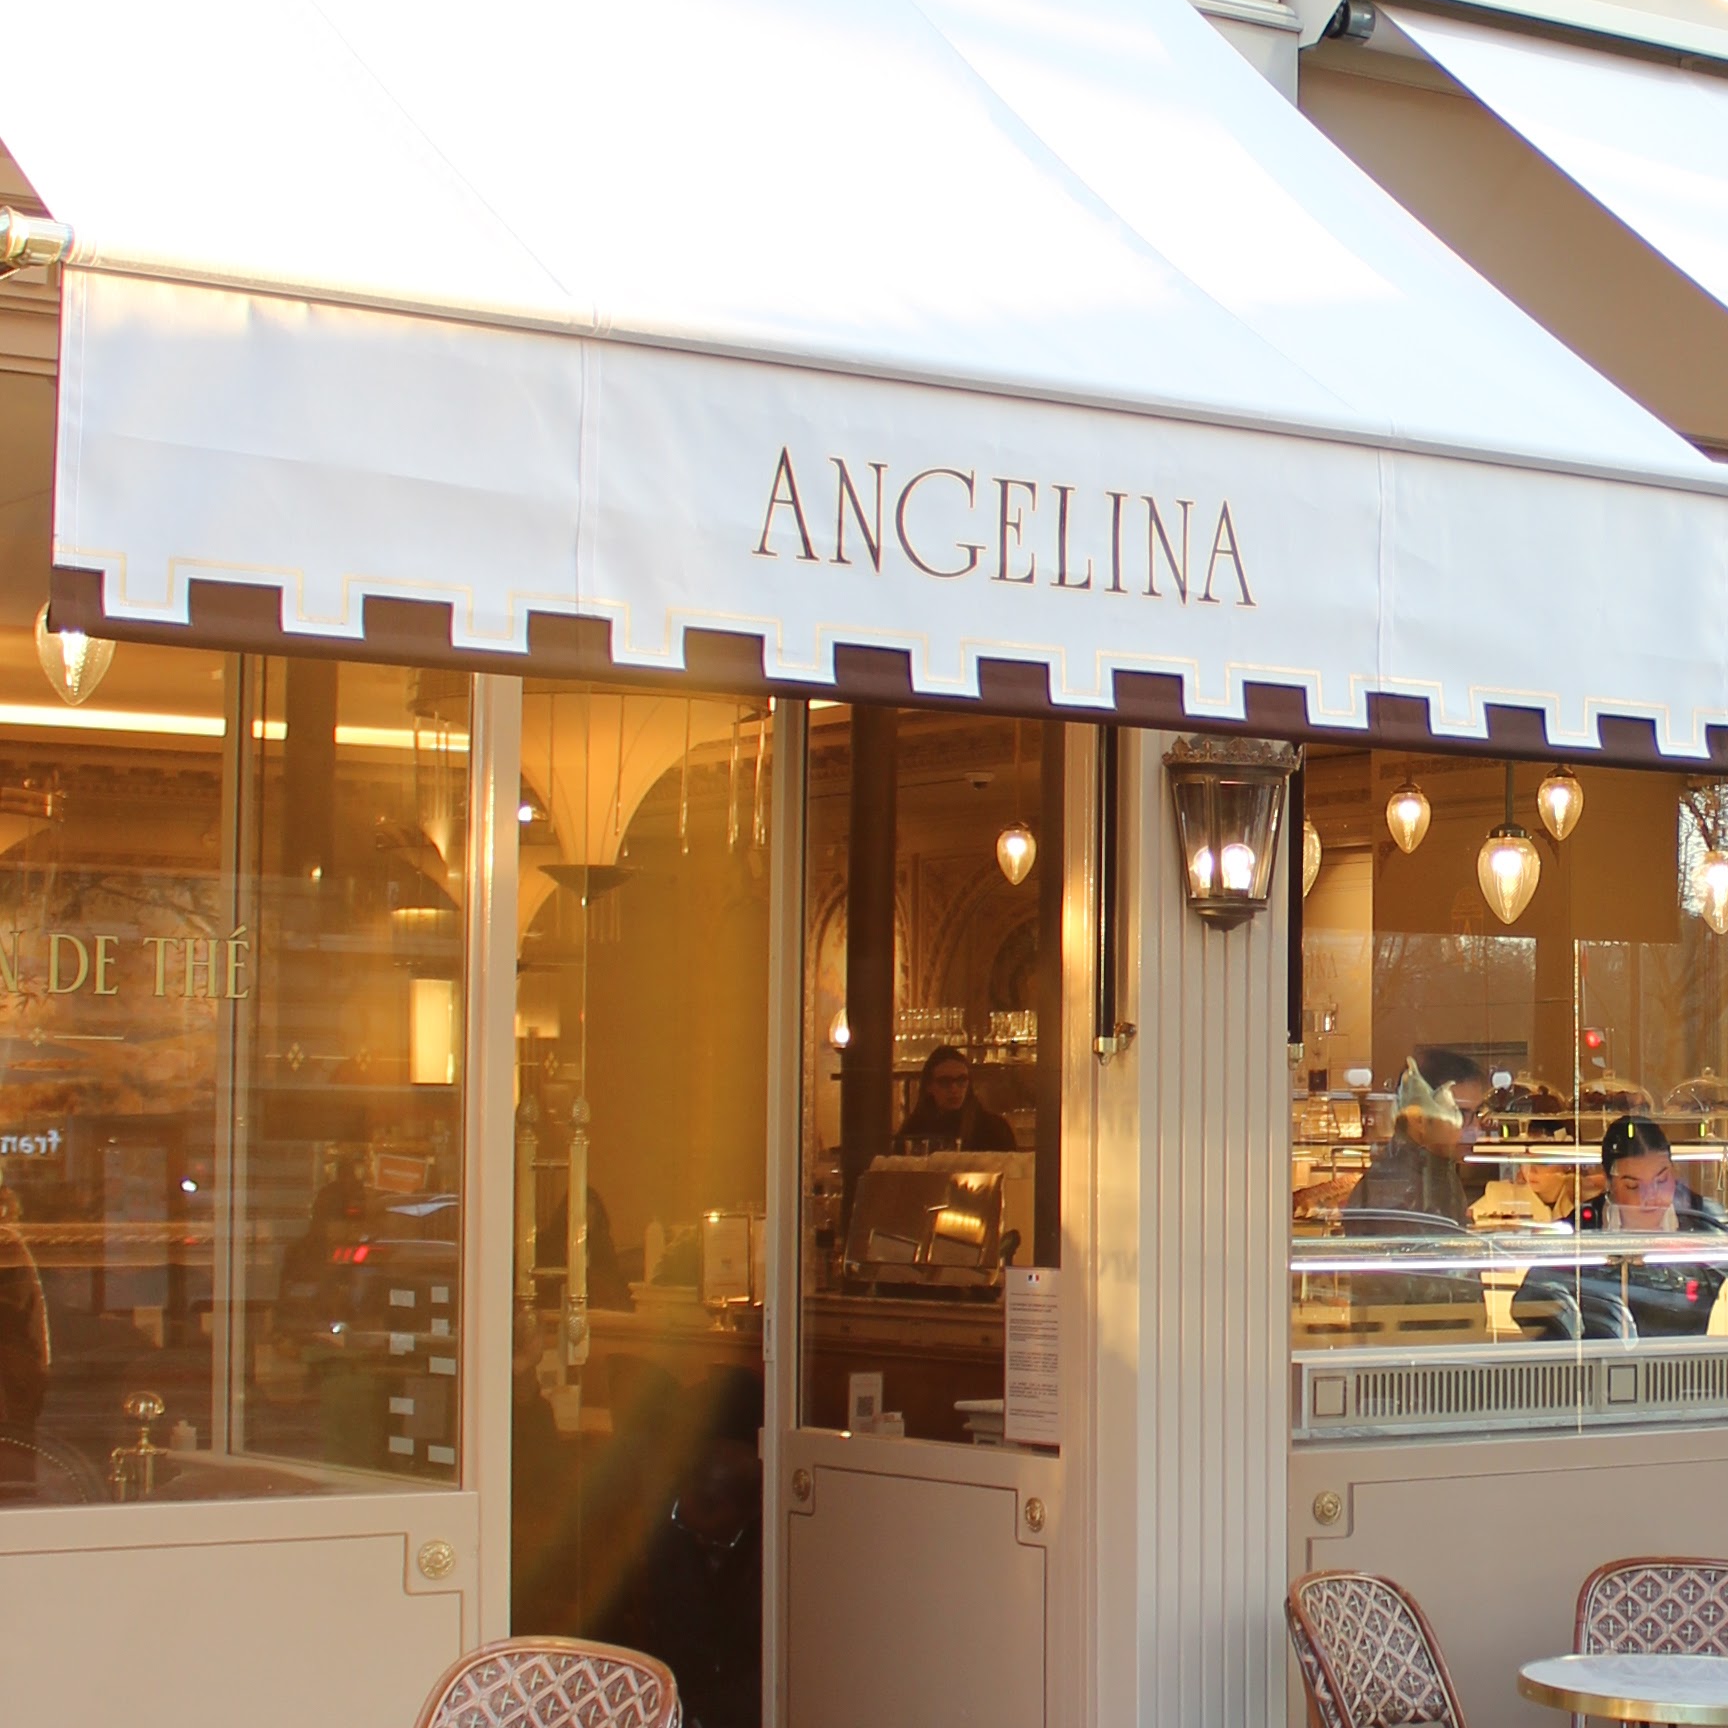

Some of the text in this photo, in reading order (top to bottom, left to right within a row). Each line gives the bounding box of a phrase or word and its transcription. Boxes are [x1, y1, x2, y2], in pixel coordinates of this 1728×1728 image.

[751, 445, 1258, 609] ANGELINA
[47, 933, 120, 995] DE
[142, 924, 250, 1000] THÉ
